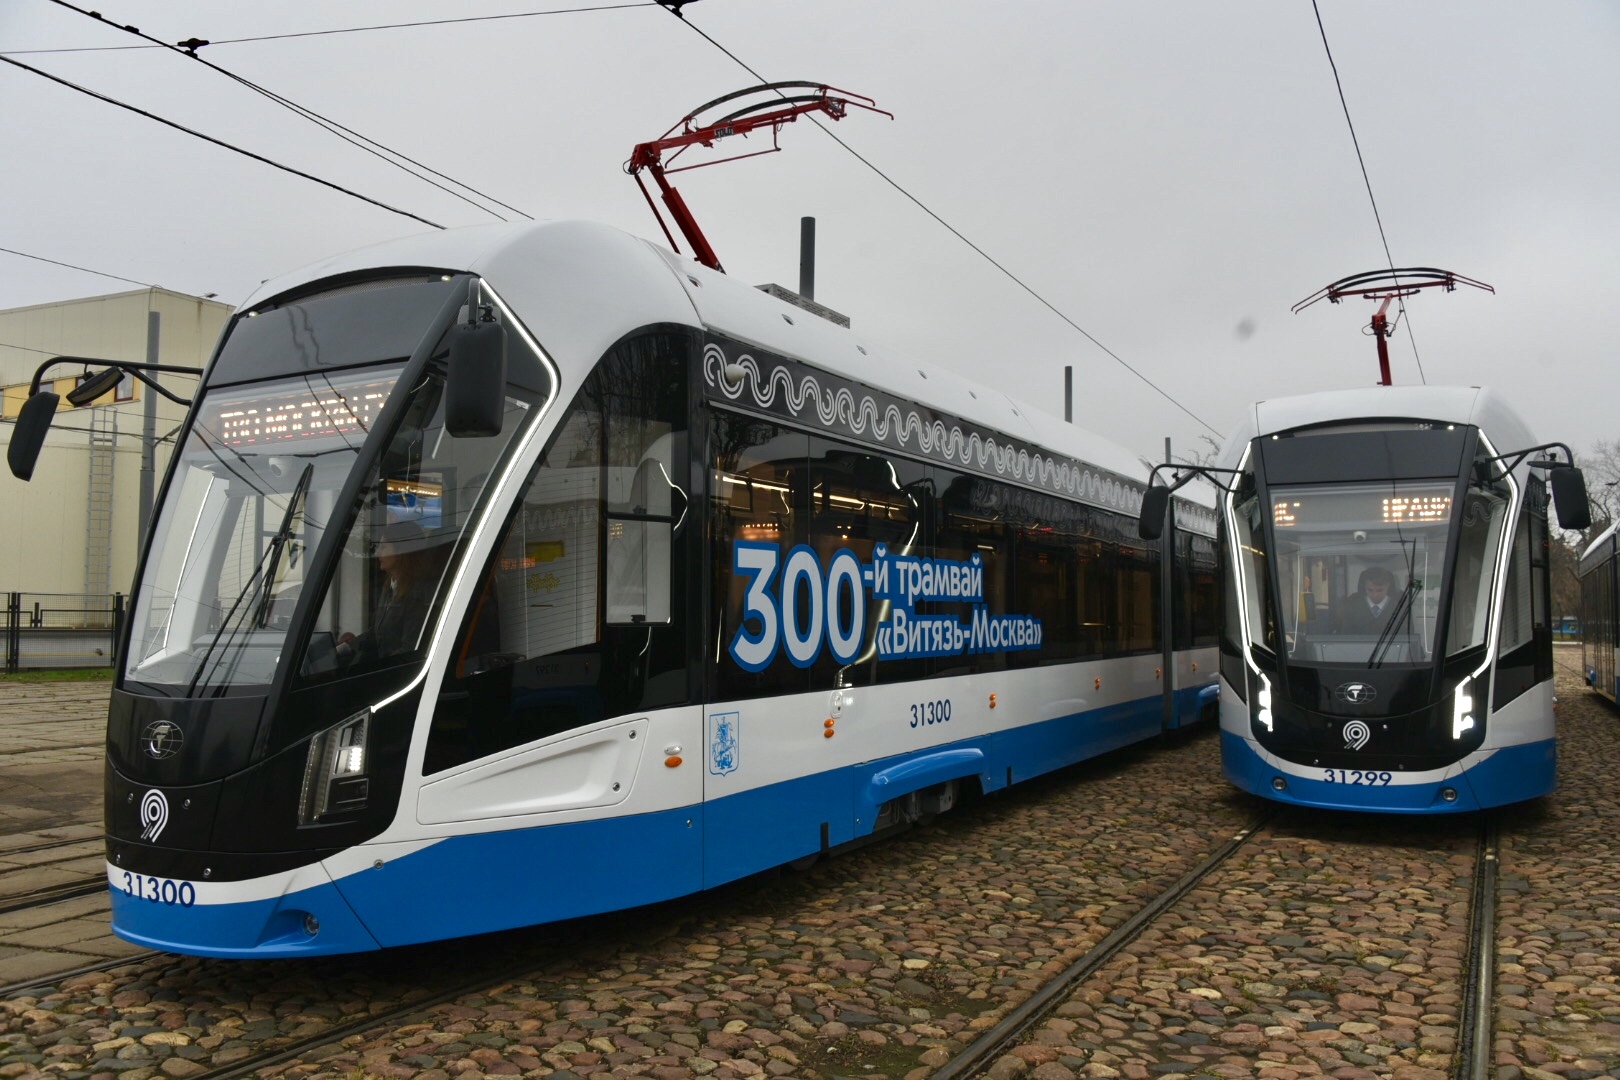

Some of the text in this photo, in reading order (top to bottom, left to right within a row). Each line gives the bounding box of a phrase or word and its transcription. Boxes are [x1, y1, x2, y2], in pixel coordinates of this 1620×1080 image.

[734, 546, 982, 665] 300-й трамвай
[877, 604, 1043, 655] «Витязь-Москва»
[910, 699, 951, 729] 31300
[1324, 768, 1392, 787] 31299
[123, 872, 196, 908] 31300
